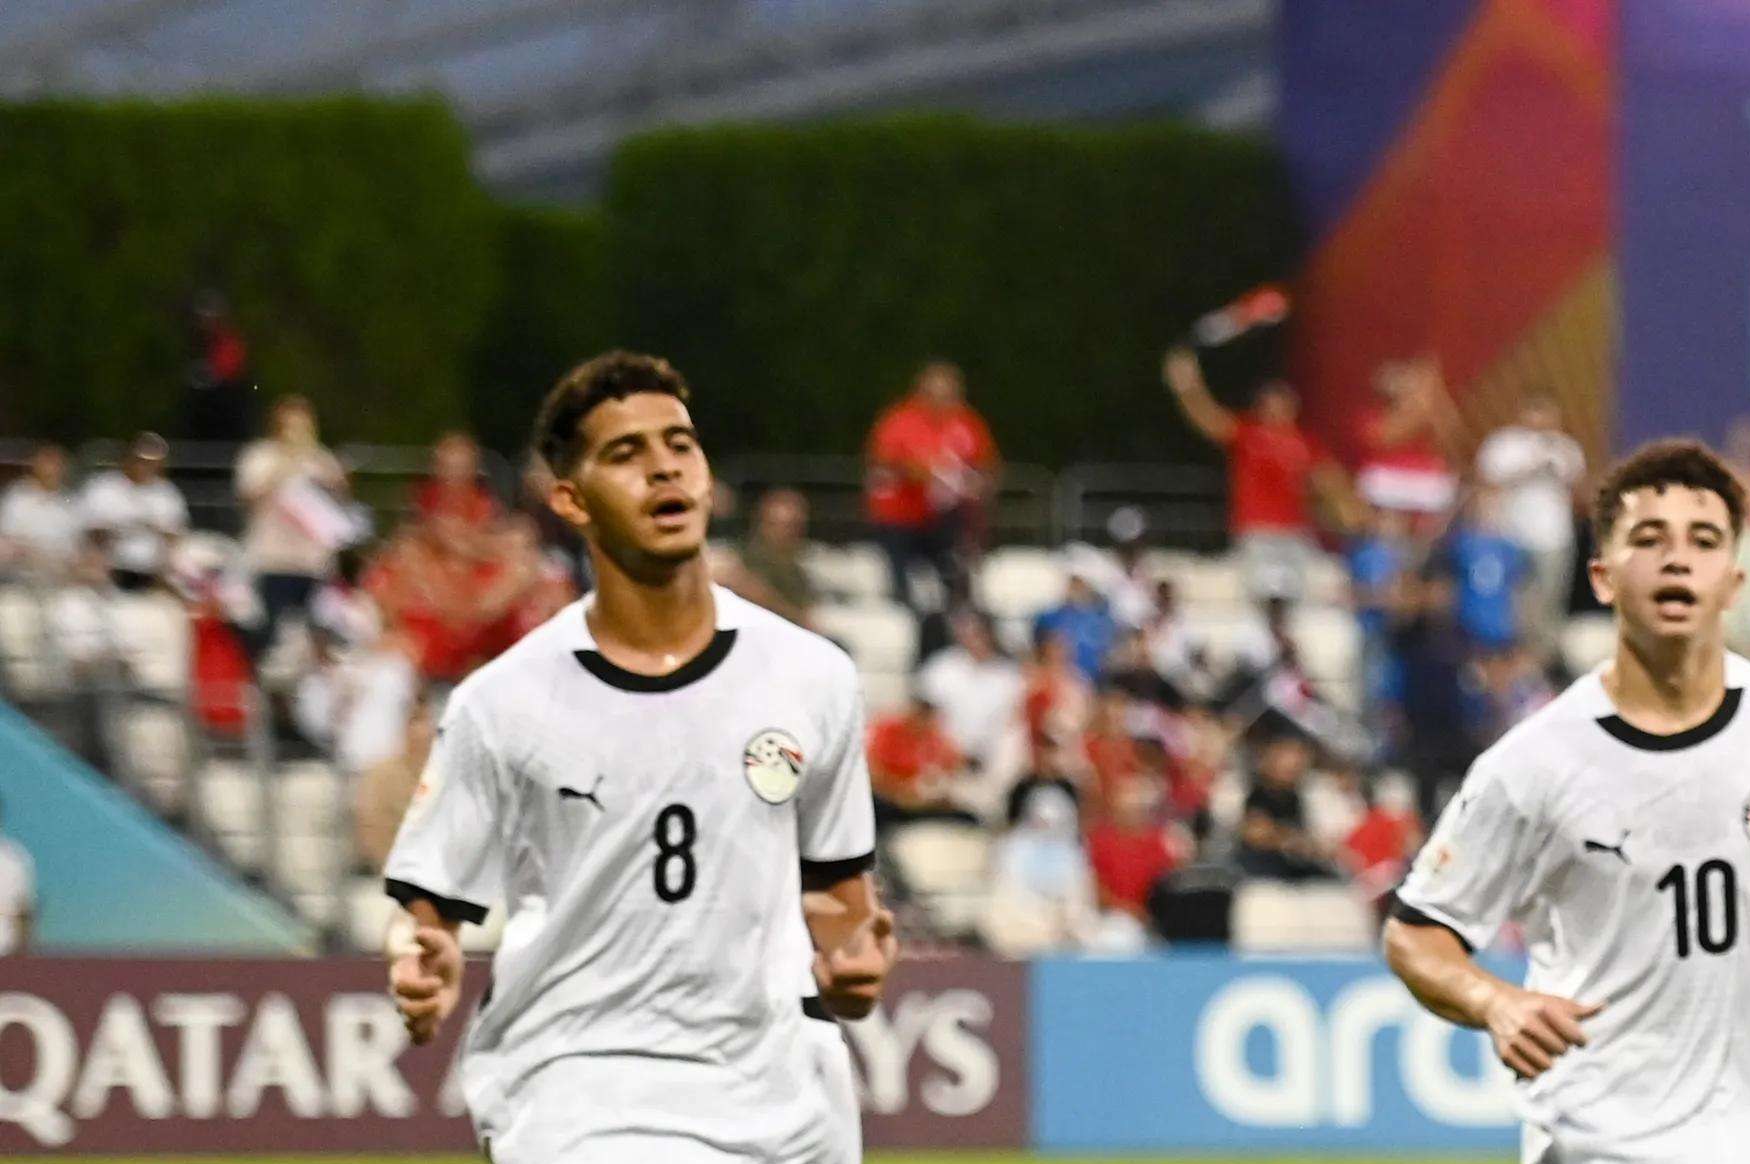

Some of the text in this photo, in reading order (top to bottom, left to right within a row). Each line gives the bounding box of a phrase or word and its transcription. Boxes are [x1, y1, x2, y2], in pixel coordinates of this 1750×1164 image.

[653, 803, 697, 904] 8
[1656, 859, 1738, 958] 10
[0, 992, 416, 1146] QATAR
